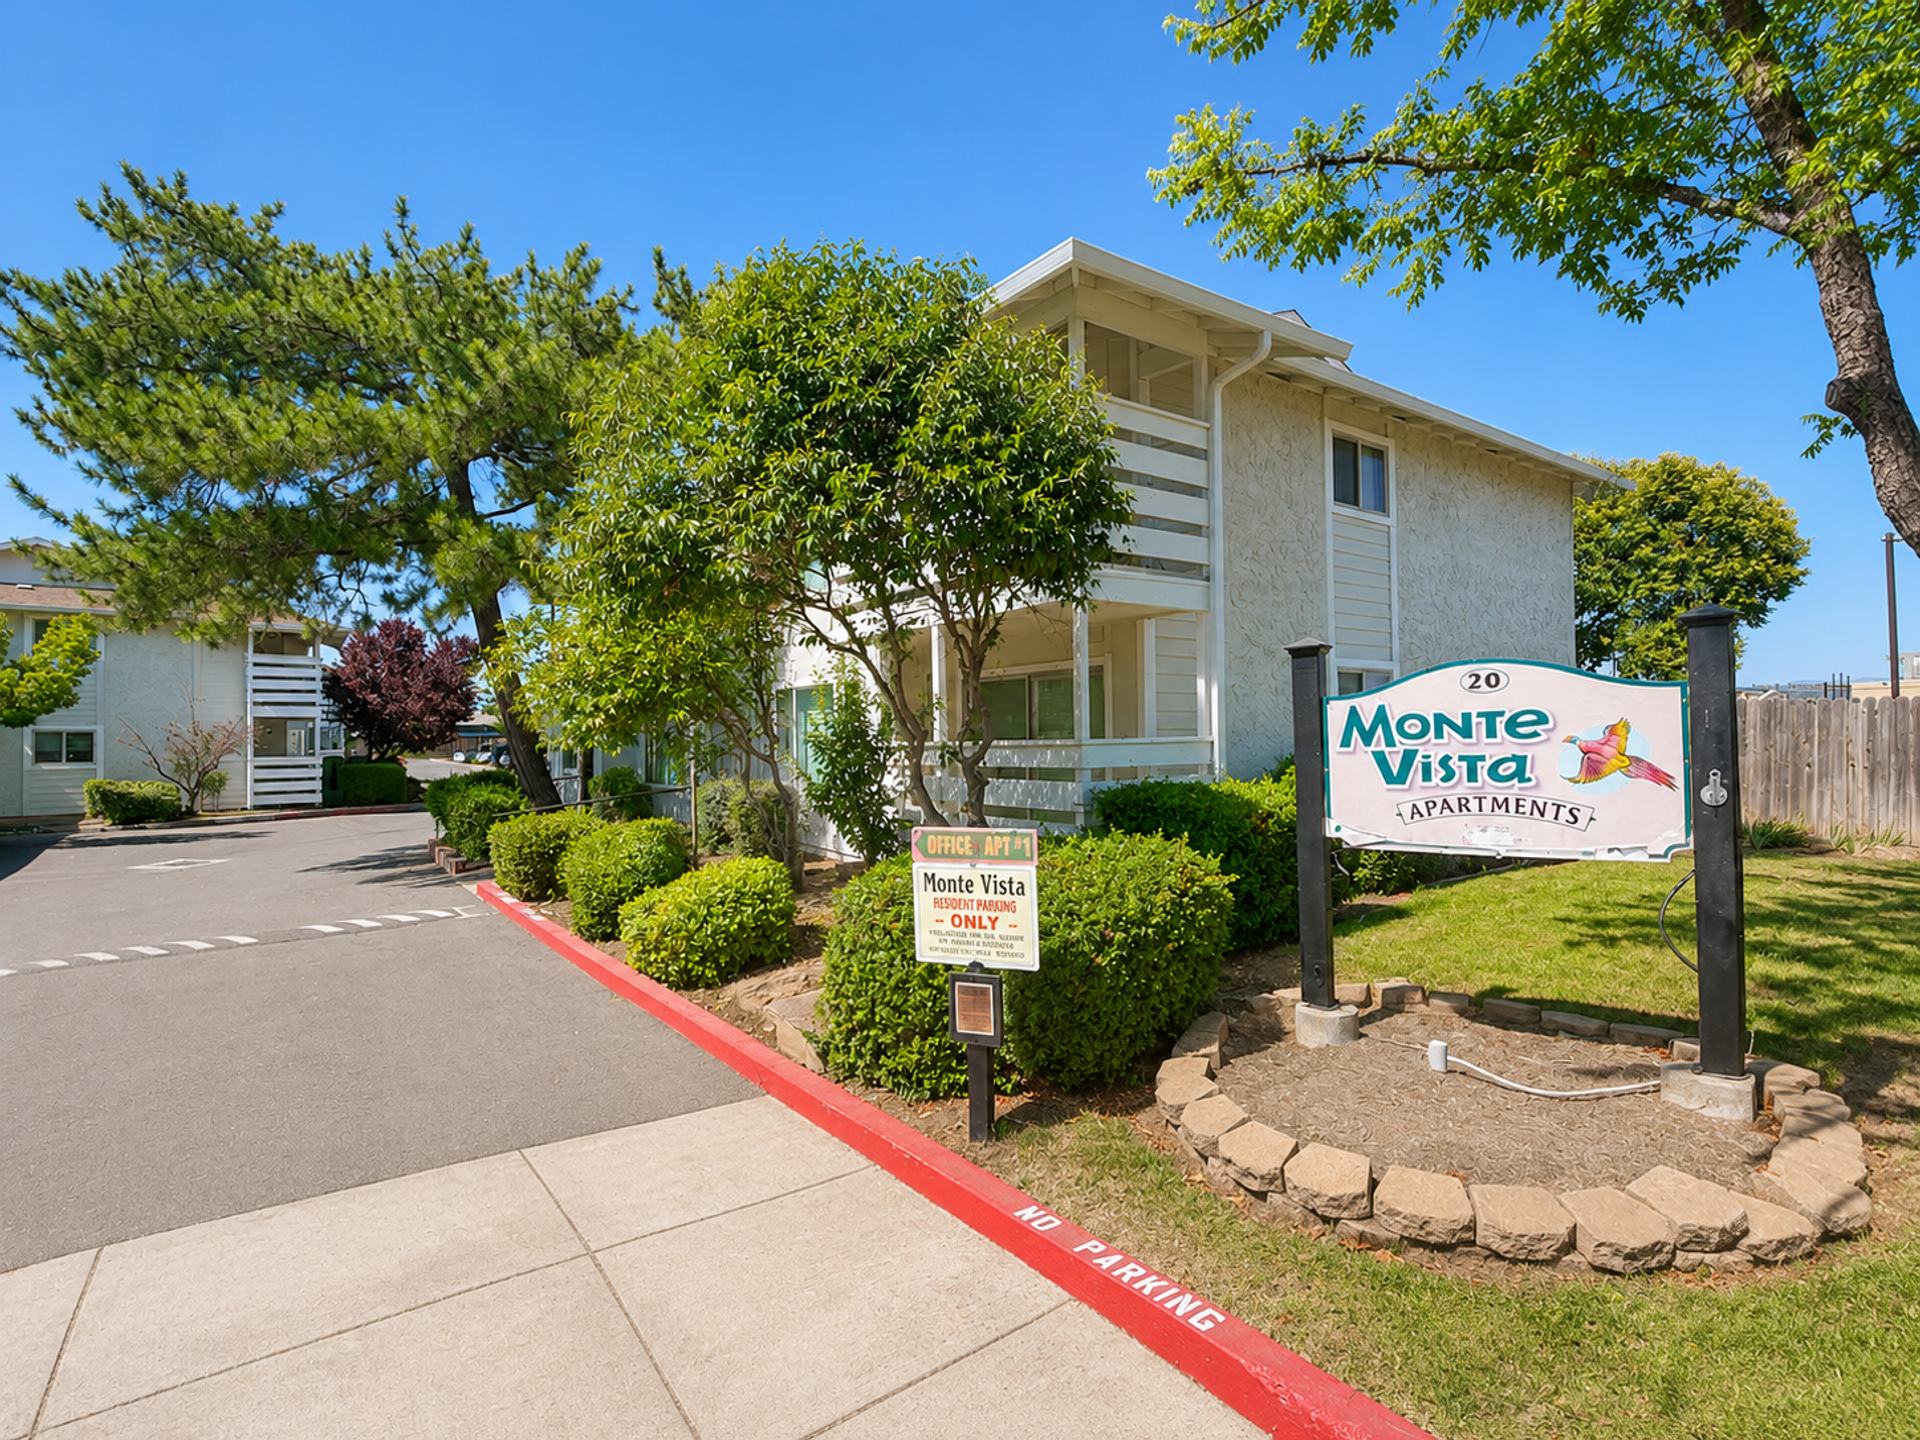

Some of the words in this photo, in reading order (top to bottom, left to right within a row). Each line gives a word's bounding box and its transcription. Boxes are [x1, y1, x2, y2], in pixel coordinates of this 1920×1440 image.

[1467, 672, 1501, 690] 20
[1409, 796, 1582, 825] APARTMENTS
[927, 835, 973, 855] OFFICE
[984, 835, 1011, 857] APT
[923, 872, 974, 894] Monte
[980, 873, 1026, 897] Vista
[950, 913, 1000, 930] ONLY
[1013, 1204, 1062, 1231] NO
[1072, 1239, 1226, 1332] PARKING
